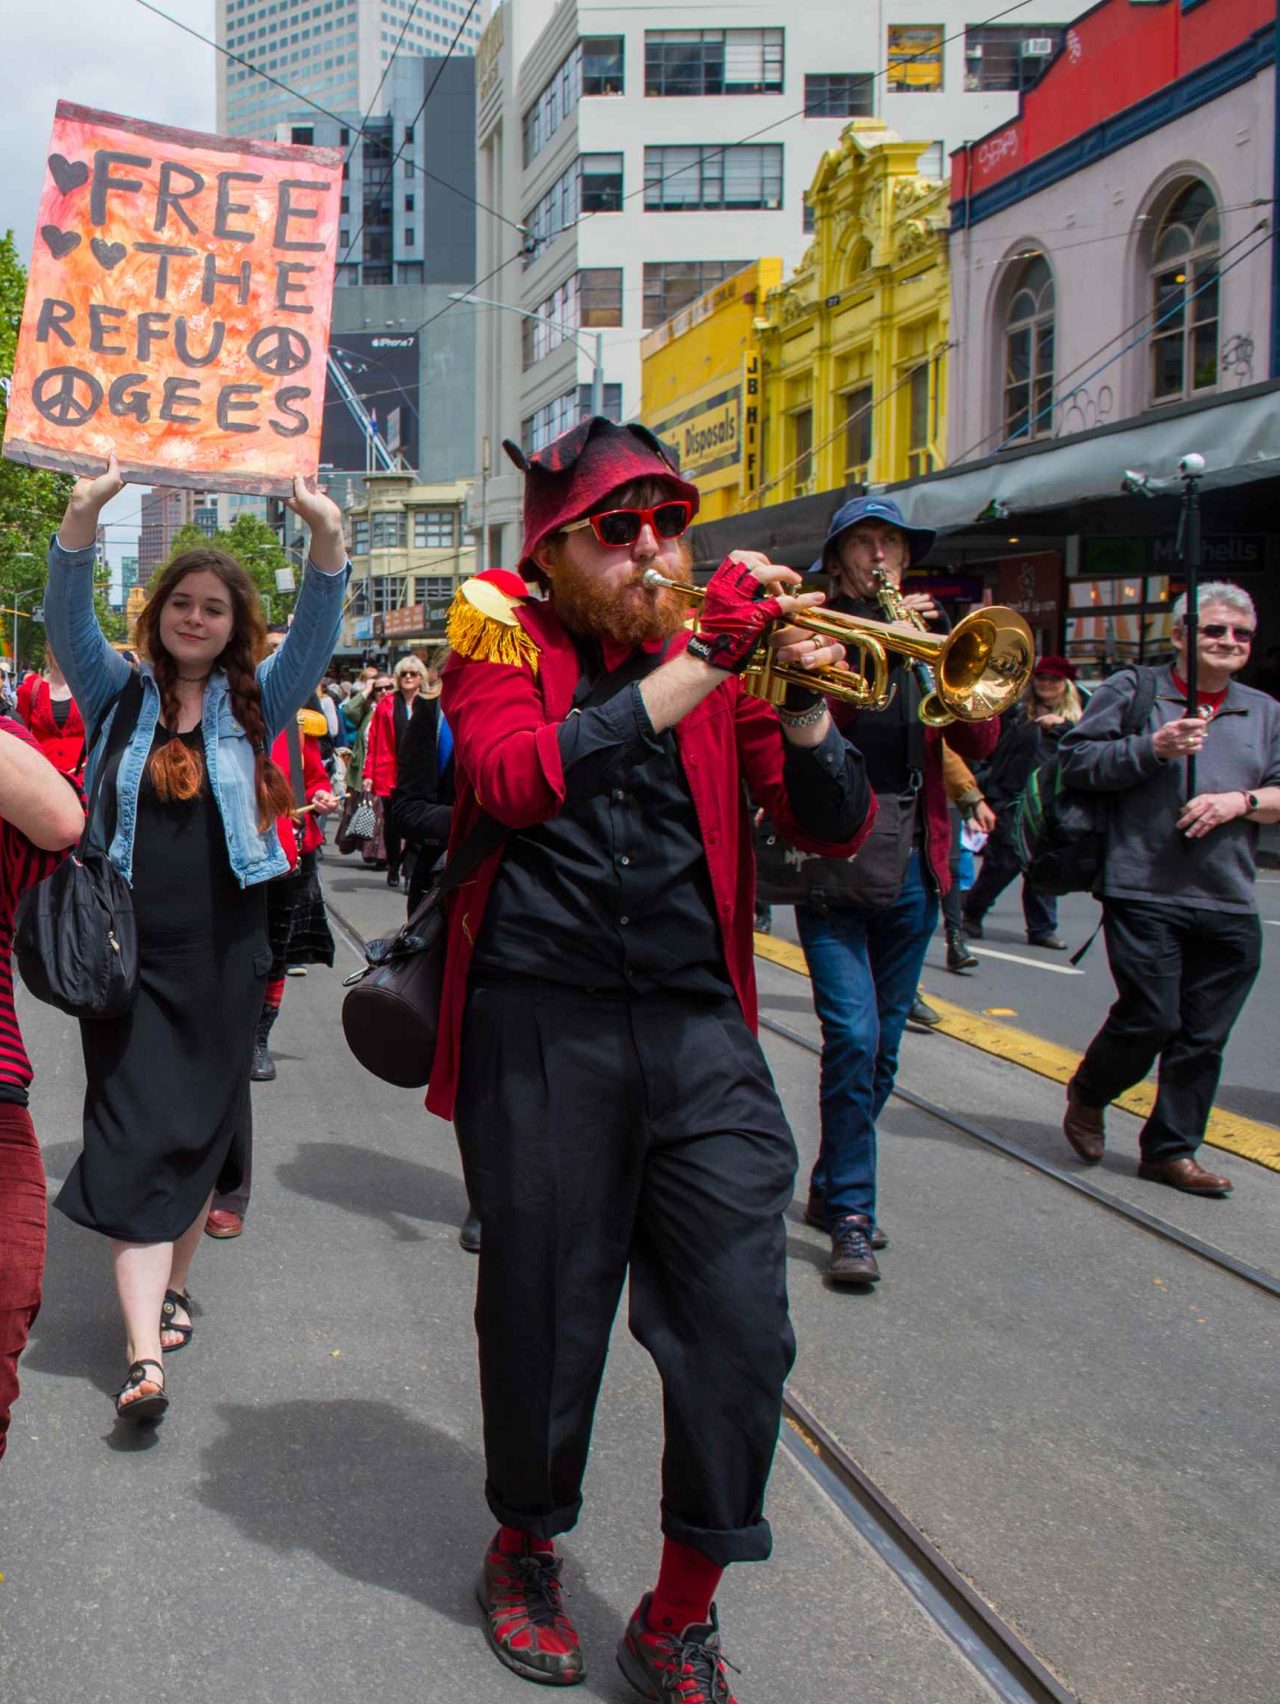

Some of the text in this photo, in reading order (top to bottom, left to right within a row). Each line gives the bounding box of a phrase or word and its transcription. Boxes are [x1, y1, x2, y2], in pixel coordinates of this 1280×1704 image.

[90, 150, 331, 252] FREE
[133, 242, 315, 313] THE
[685, 407, 736, 459] Disposals
